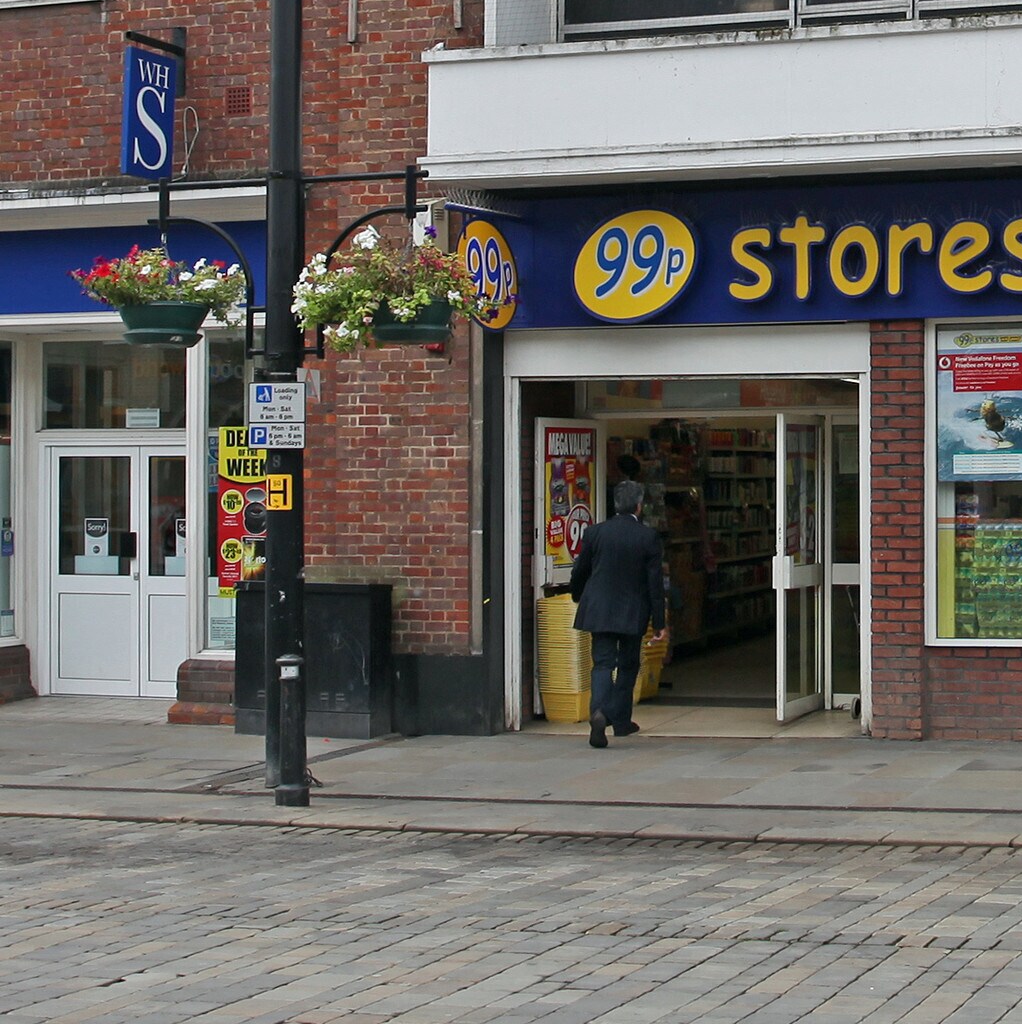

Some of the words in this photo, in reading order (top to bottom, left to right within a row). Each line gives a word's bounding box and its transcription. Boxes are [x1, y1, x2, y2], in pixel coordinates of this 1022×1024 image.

[138, 58, 170, 89] WH
[134, 86, 167, 170] S
[466, 236, 514, 304] 99p
[594, 226, 685, 299] 99p
[226, 430, 248, 447] DE
[254, 429, 265, 443] P
[549, 432, 569, 455] MEGA
[569, 432, 592, 456] VALUE!
[87, 523, 106, 533] Sorry!
